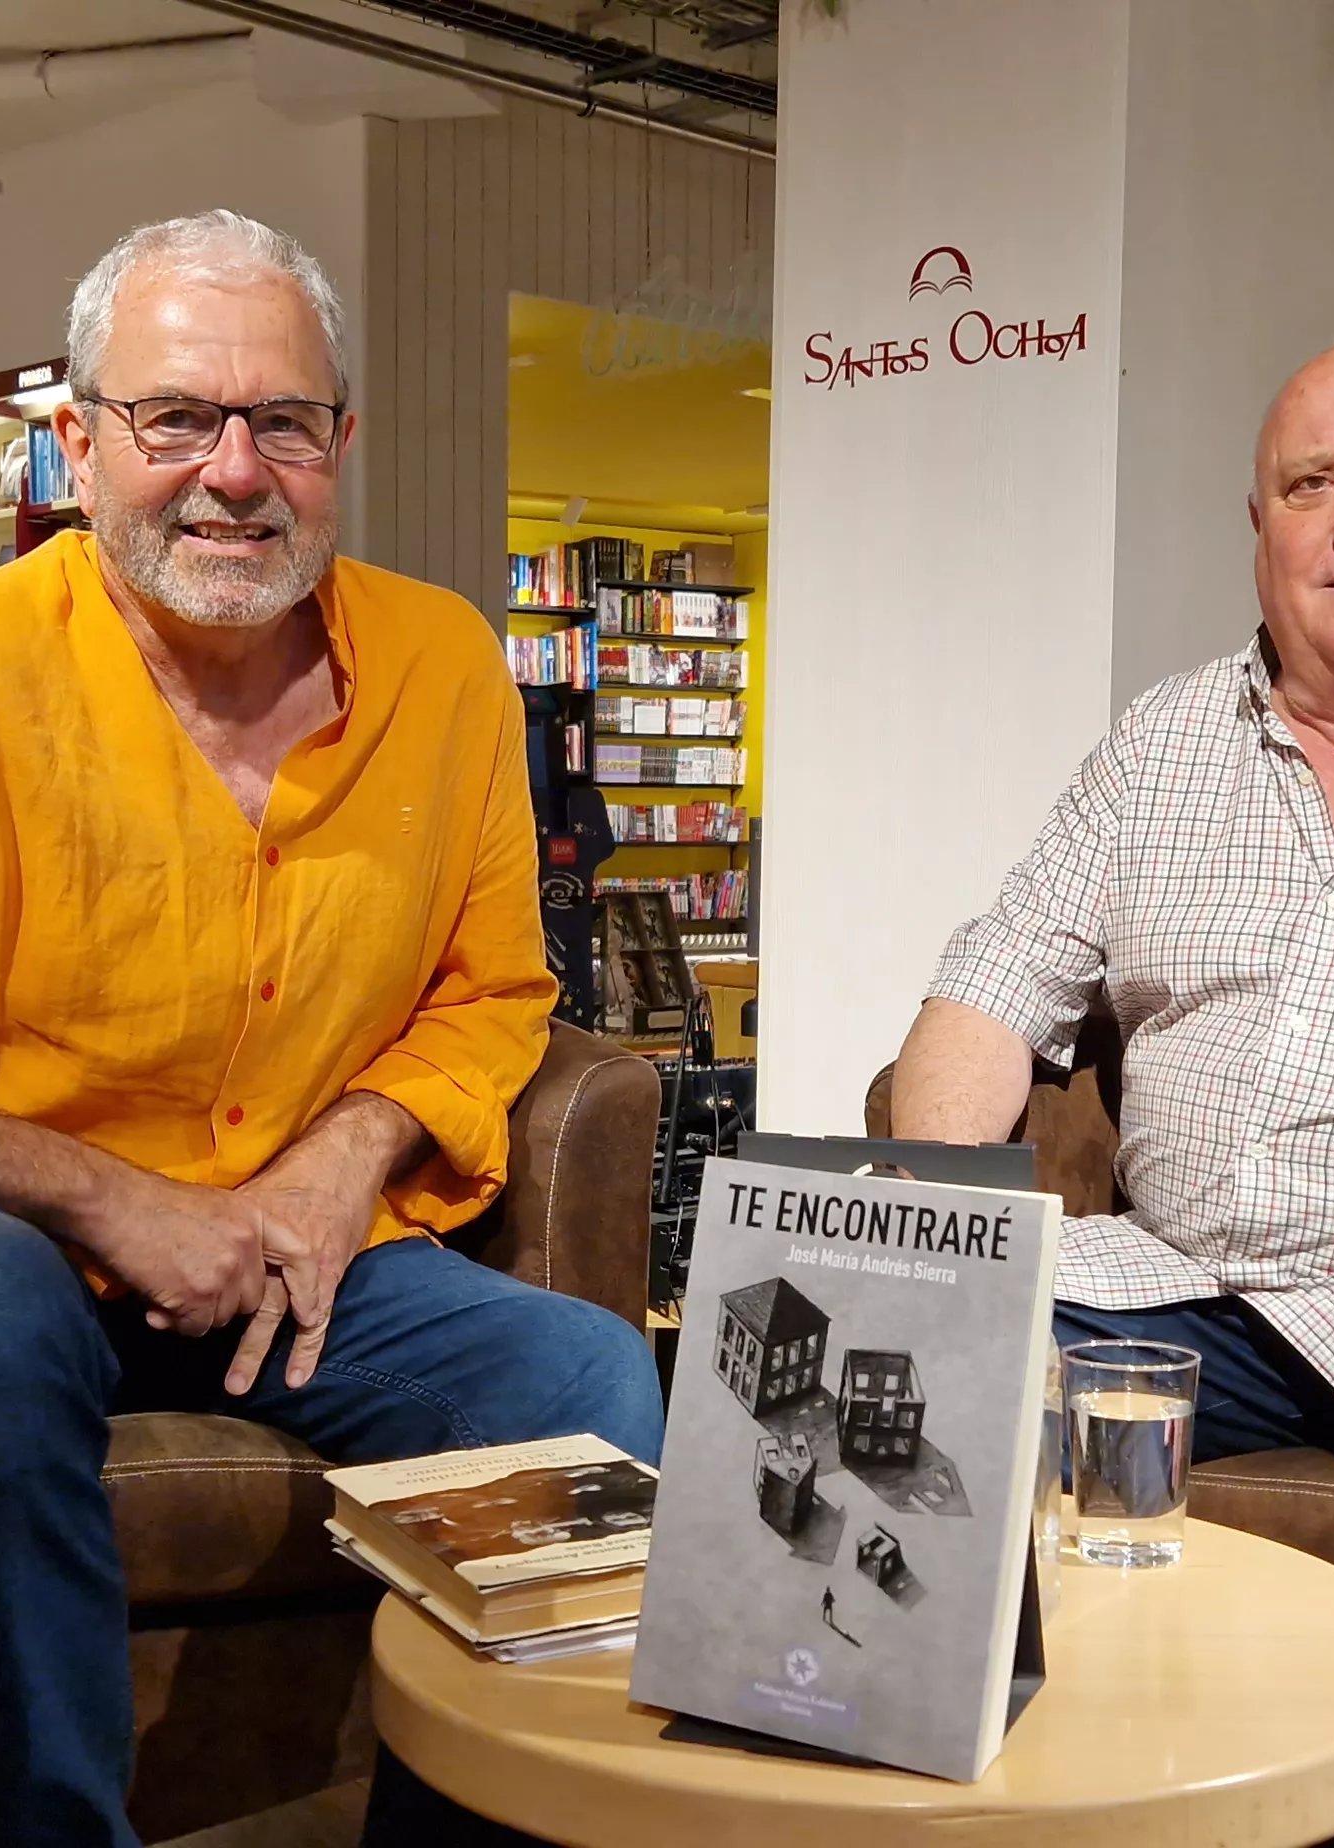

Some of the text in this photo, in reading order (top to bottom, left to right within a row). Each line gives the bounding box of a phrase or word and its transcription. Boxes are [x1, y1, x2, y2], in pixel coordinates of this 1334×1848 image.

[728, 1183, 1012, 1261] TE ENCONTRARÉ
[785, 1243, 957, 1284] José María Andrés Sierra
[527, 1451, 557, 1459] del
[548, 1454, 586, 1463] Los
[395, 1467, 483, 1485] perdidos
